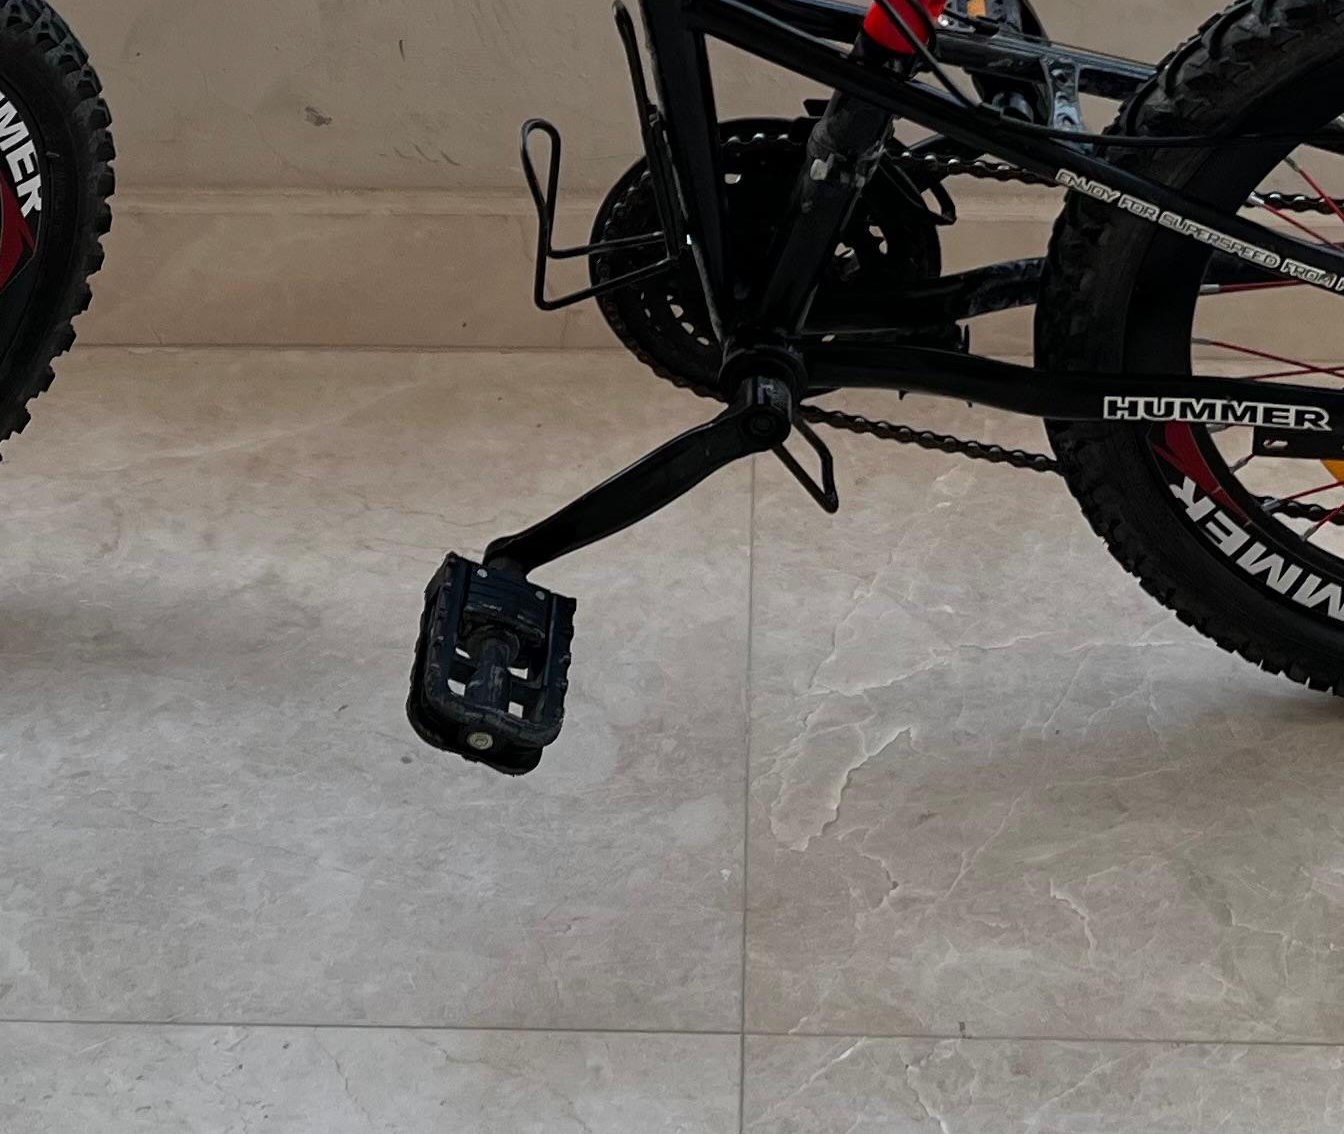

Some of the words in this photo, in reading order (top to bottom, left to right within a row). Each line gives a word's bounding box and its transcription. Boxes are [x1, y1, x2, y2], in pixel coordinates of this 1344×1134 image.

[1055, 168, 1121, 203] ENJOY
[1117, 193, 1161, 222] FOR
[1157, 211, 1281, 269] SUPERSPEED
[1280, 258, 1338, 289] FROM
[1103, 396, 1333, 431] HUMMER
